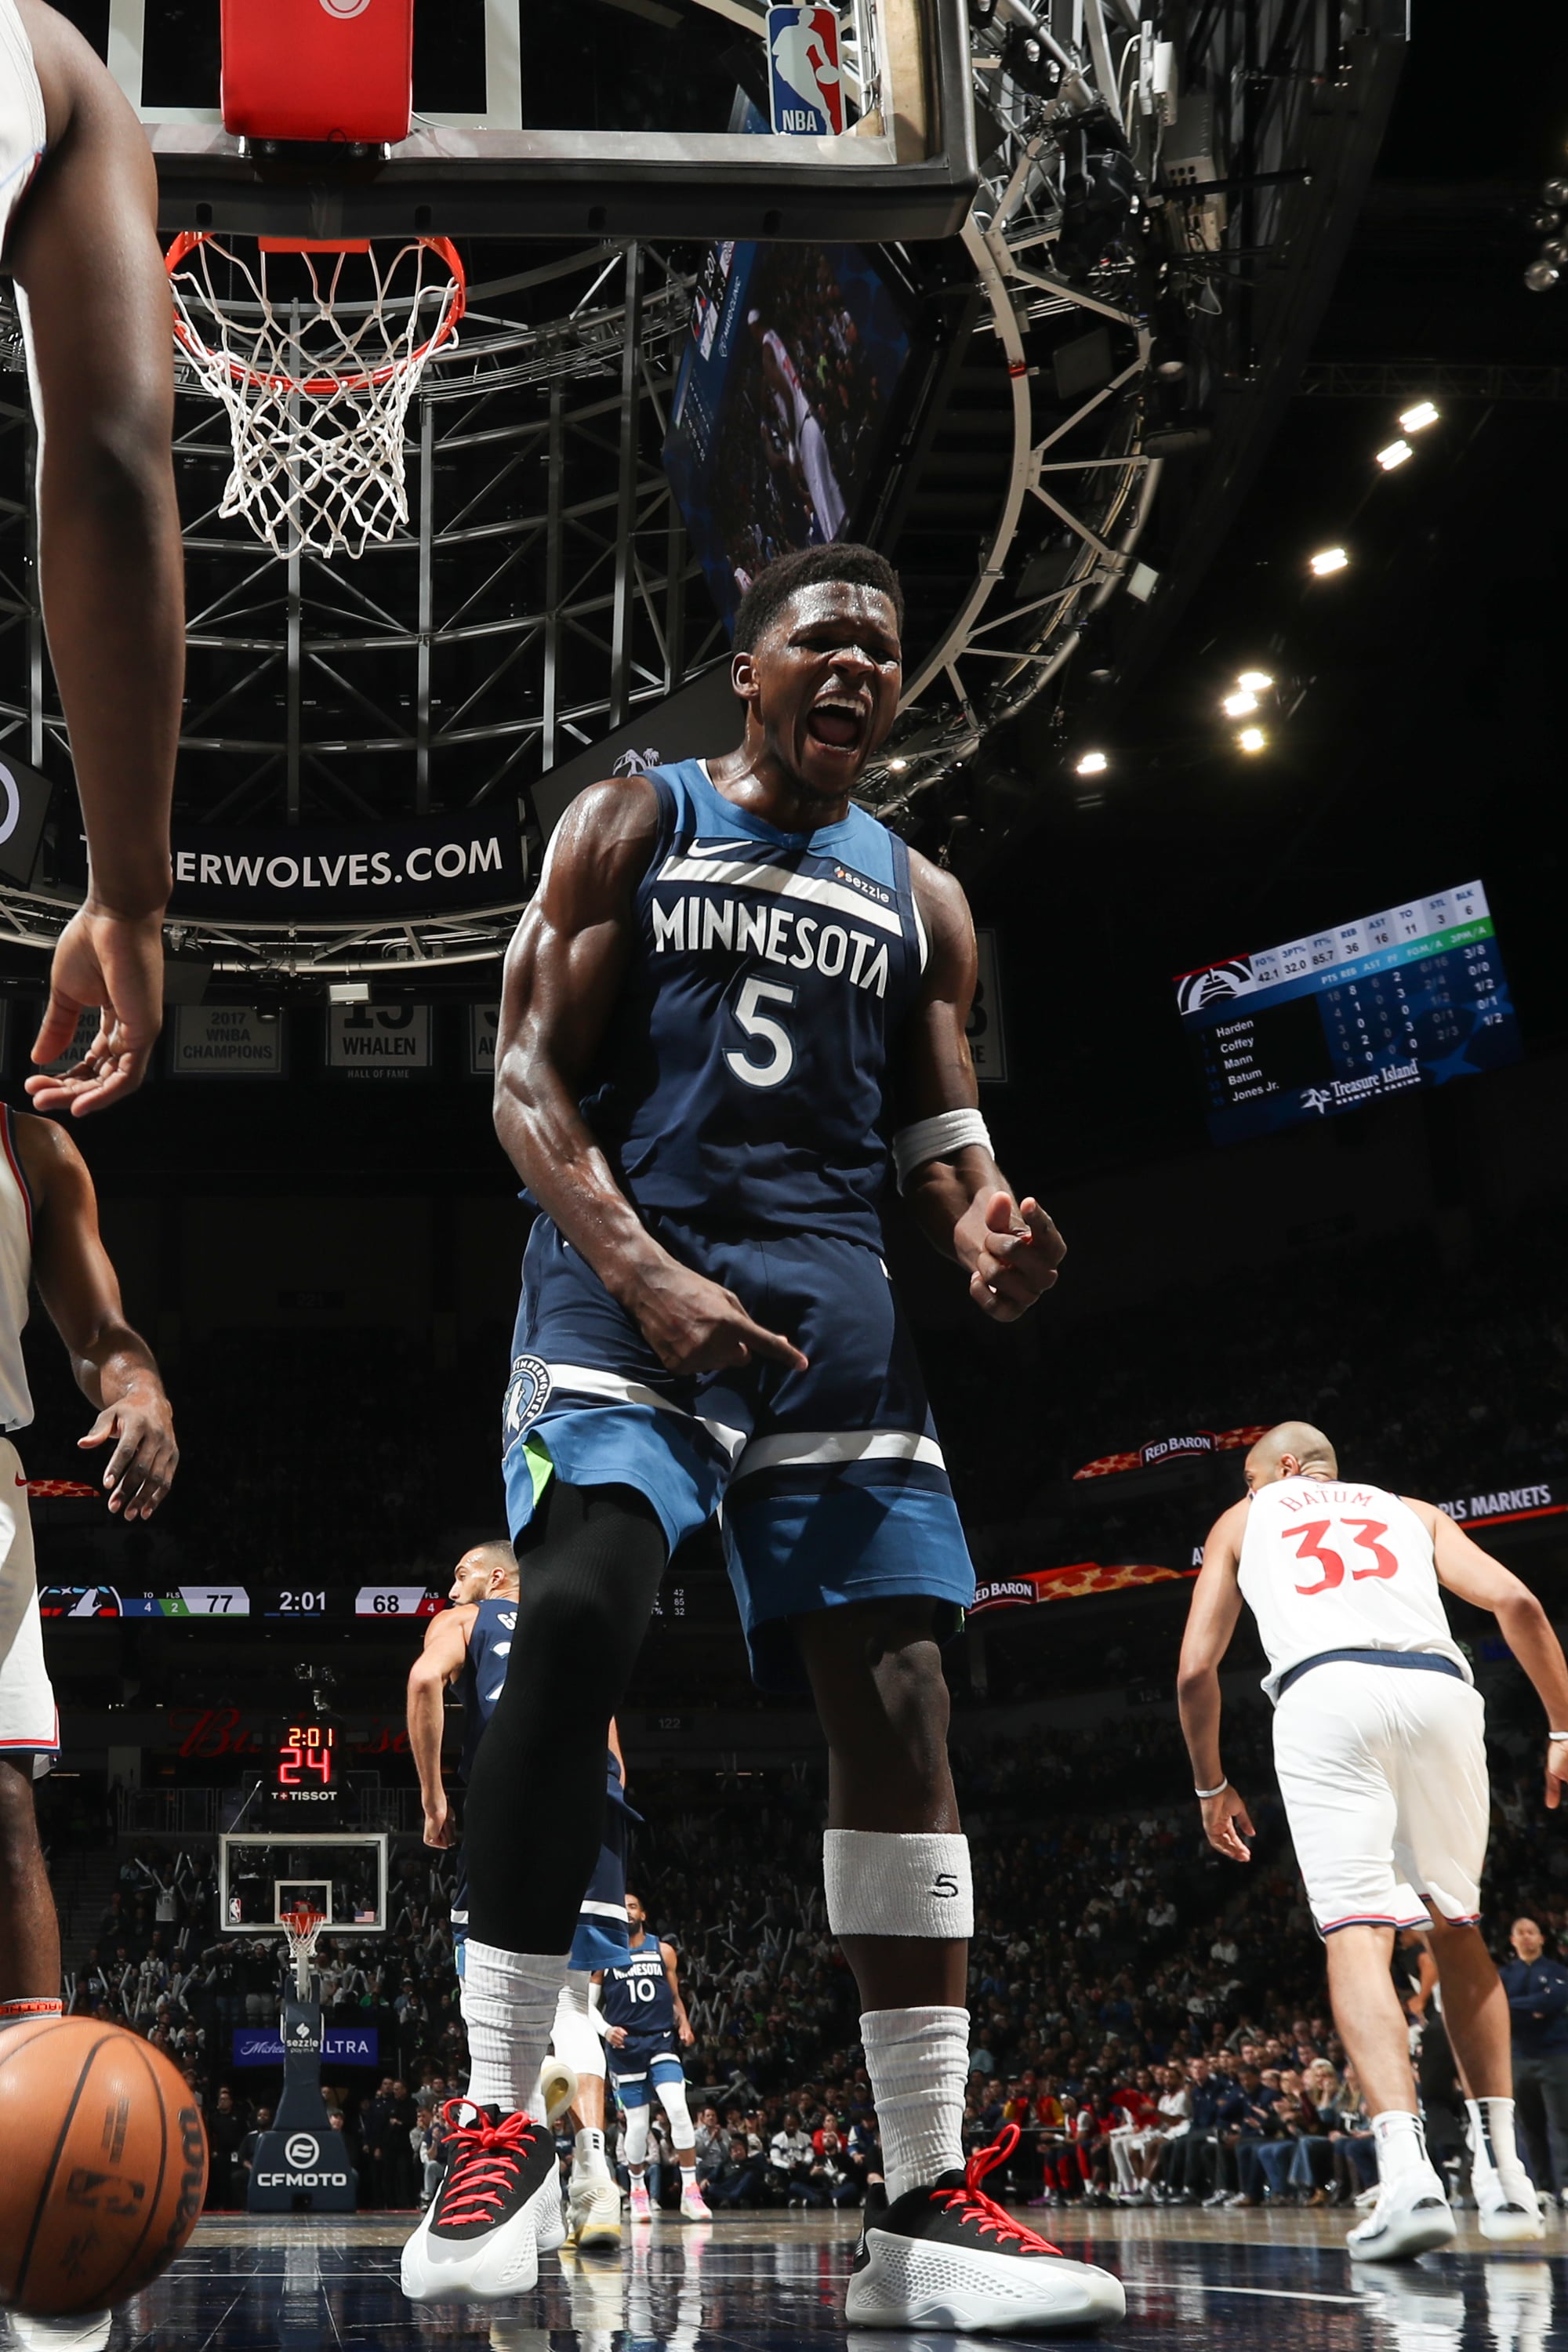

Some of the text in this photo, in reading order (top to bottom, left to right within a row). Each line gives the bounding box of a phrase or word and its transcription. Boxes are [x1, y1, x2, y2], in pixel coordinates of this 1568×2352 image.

[782, 110, 818, 132] NBA
[844, 873, 890, 903] sezzle
[1340, 927, 1357, 939] REB
[1369, 918, 1386, 931] AST
[1399, 909, 1414, 919] TO
[652, 896, 889, 1000] MINNESOTA
[1258, 905, 1473, 982] 42.1 32.0 85.7 36 16 11 3 6
[1321, 972, 1338, 985] PTS
[1363, 959, 1381, 972] AST
[1216, 1019, 1254, 1038] Harden
[1348, 985, 1357, 996] 8
[1392, 971, 1402, 982] 2
[1464, 944, 1486, 960] 3/8
[211, 1012, 247, 1025] 2017
[1220, 1036, 1254, 1054] Coffey
[1354, 1001, 1361, 1012] 1
[1396, 988, 1406, 999] 3
[1468, 961, 1490, 976] 0/0
[206, 1028, 252, 1042] WNBA
[724, 975, 797, 1088] 5
[1223, 1054, 1254, 1070] Mann
[1357, 1018, 1366, 1029] 0
[1401, 1004, 1410, 1015] 0
[1474, 978, 1495, 993] 1/2
[183, 1044, 273, 1058] CHAMPIONS
[342, 1036, 416, 1056] WHALEN
[1228, 1069, 1263, 1086] Batum
[1361, 1034, 1370, 1045] 2
[1406, 1022, 1414, 1032] 3
[1475, 995, 1498, 1010] 0/1
[1232, 1085, 1264, 1102] Jones
[1265, 1080, 1280, 1093] Jr.
[1365, 1051, 1374, 1062] 0
[1409, 1037, 1418, 1048] 0
[1483, 1012, 1504, 1027] 1/2
[347, 1069, 410, 1079] HALL OF FAME
[1330, 1058, 1420, 1098] Treasure Island
[1145, 1436, 1211, 1462] RED BARON
[1279, 1490, 1374, 1512] BATUM
[1470, 1483, 1552, 1517] MARKETS
[1281, 1516, 1399, 1595] 33
[144, 1591, 435, 1613] 4 2 77 2:01 68 4
[990, 1582, 1033, 1597] BARON
[289, 1727, 333, 1747] 2:01
[279, 1748, 331, 1784] 24
[289, 1791, 337, 1801] TISSOT
[927, 1873, 959, 1899] 5
[626, 1978, 656, 2003] 10
[286, 2038, 319, 2048] sezzle
[257, 2172, 347, 2187] CFMOTO
